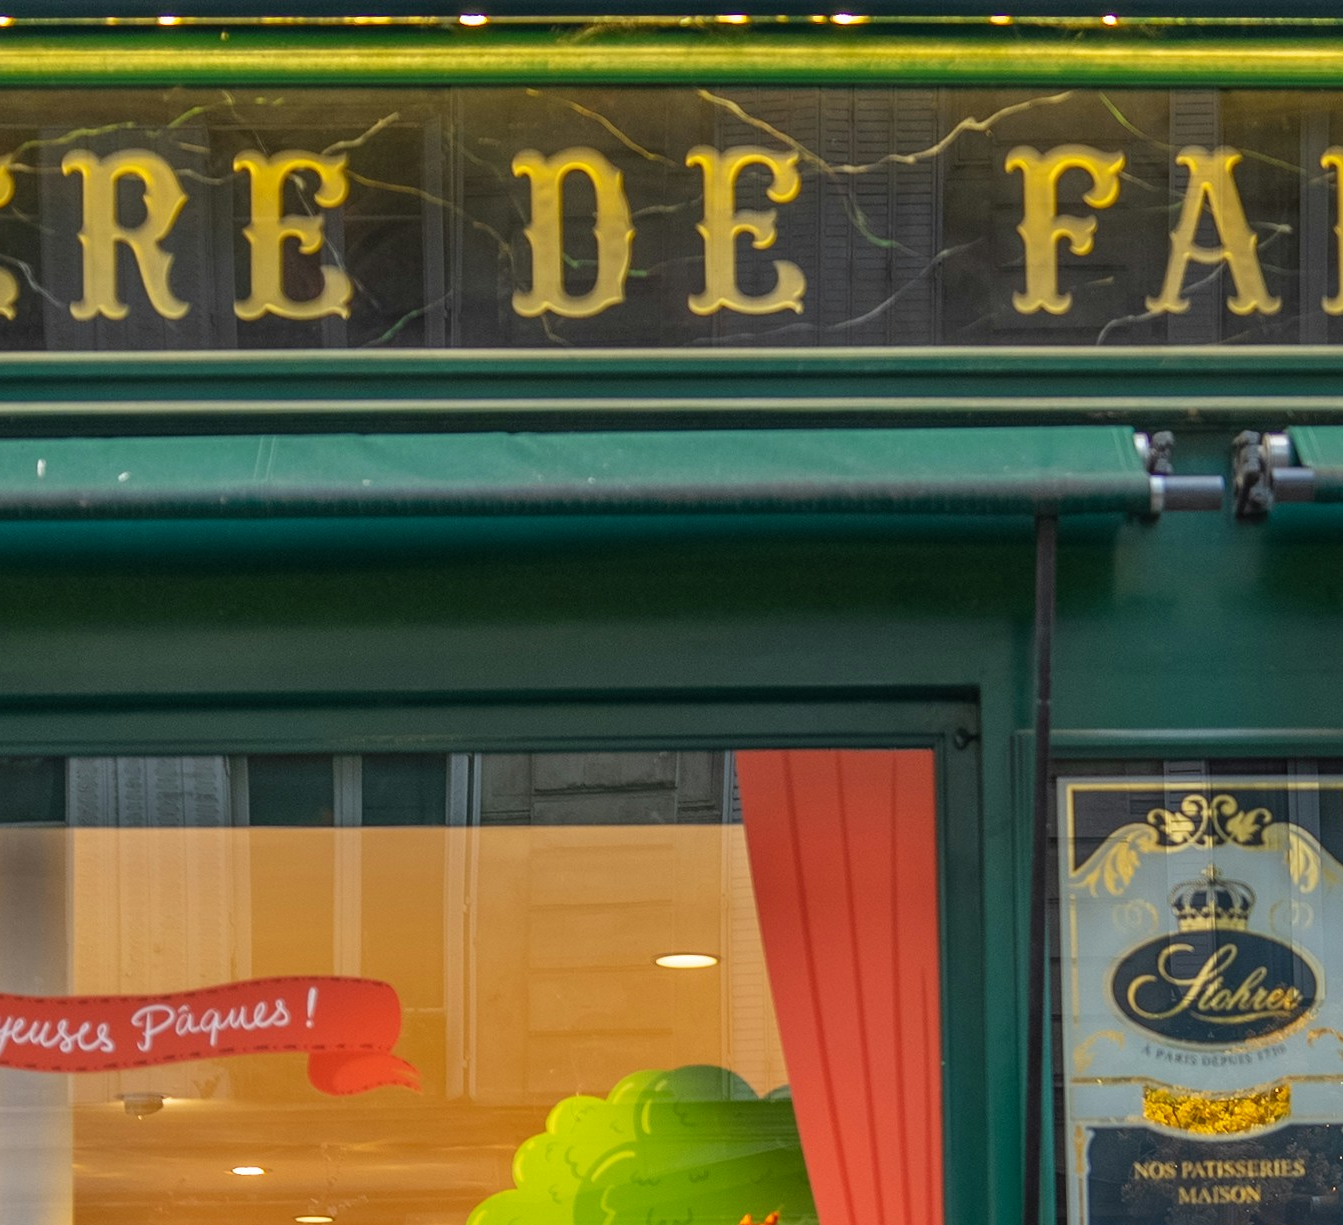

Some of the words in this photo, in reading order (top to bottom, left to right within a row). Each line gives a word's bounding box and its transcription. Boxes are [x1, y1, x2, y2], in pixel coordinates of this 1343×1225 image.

[511, 145, 807, 318] DE
[1127, 943, 1304, 1022] Stohrer
[131, 997, 292, 1054] Pâques
[1155, 1047, 1199, 1067] PARIS
[1201, 1053, 1254, 1068] DEPUIS
[1133, 1162, 1176, 1180] NOS
[1181, 1158, 1306, 1180] PATISSERIES
[1177, 1185, 1262, 1206] MAISON
